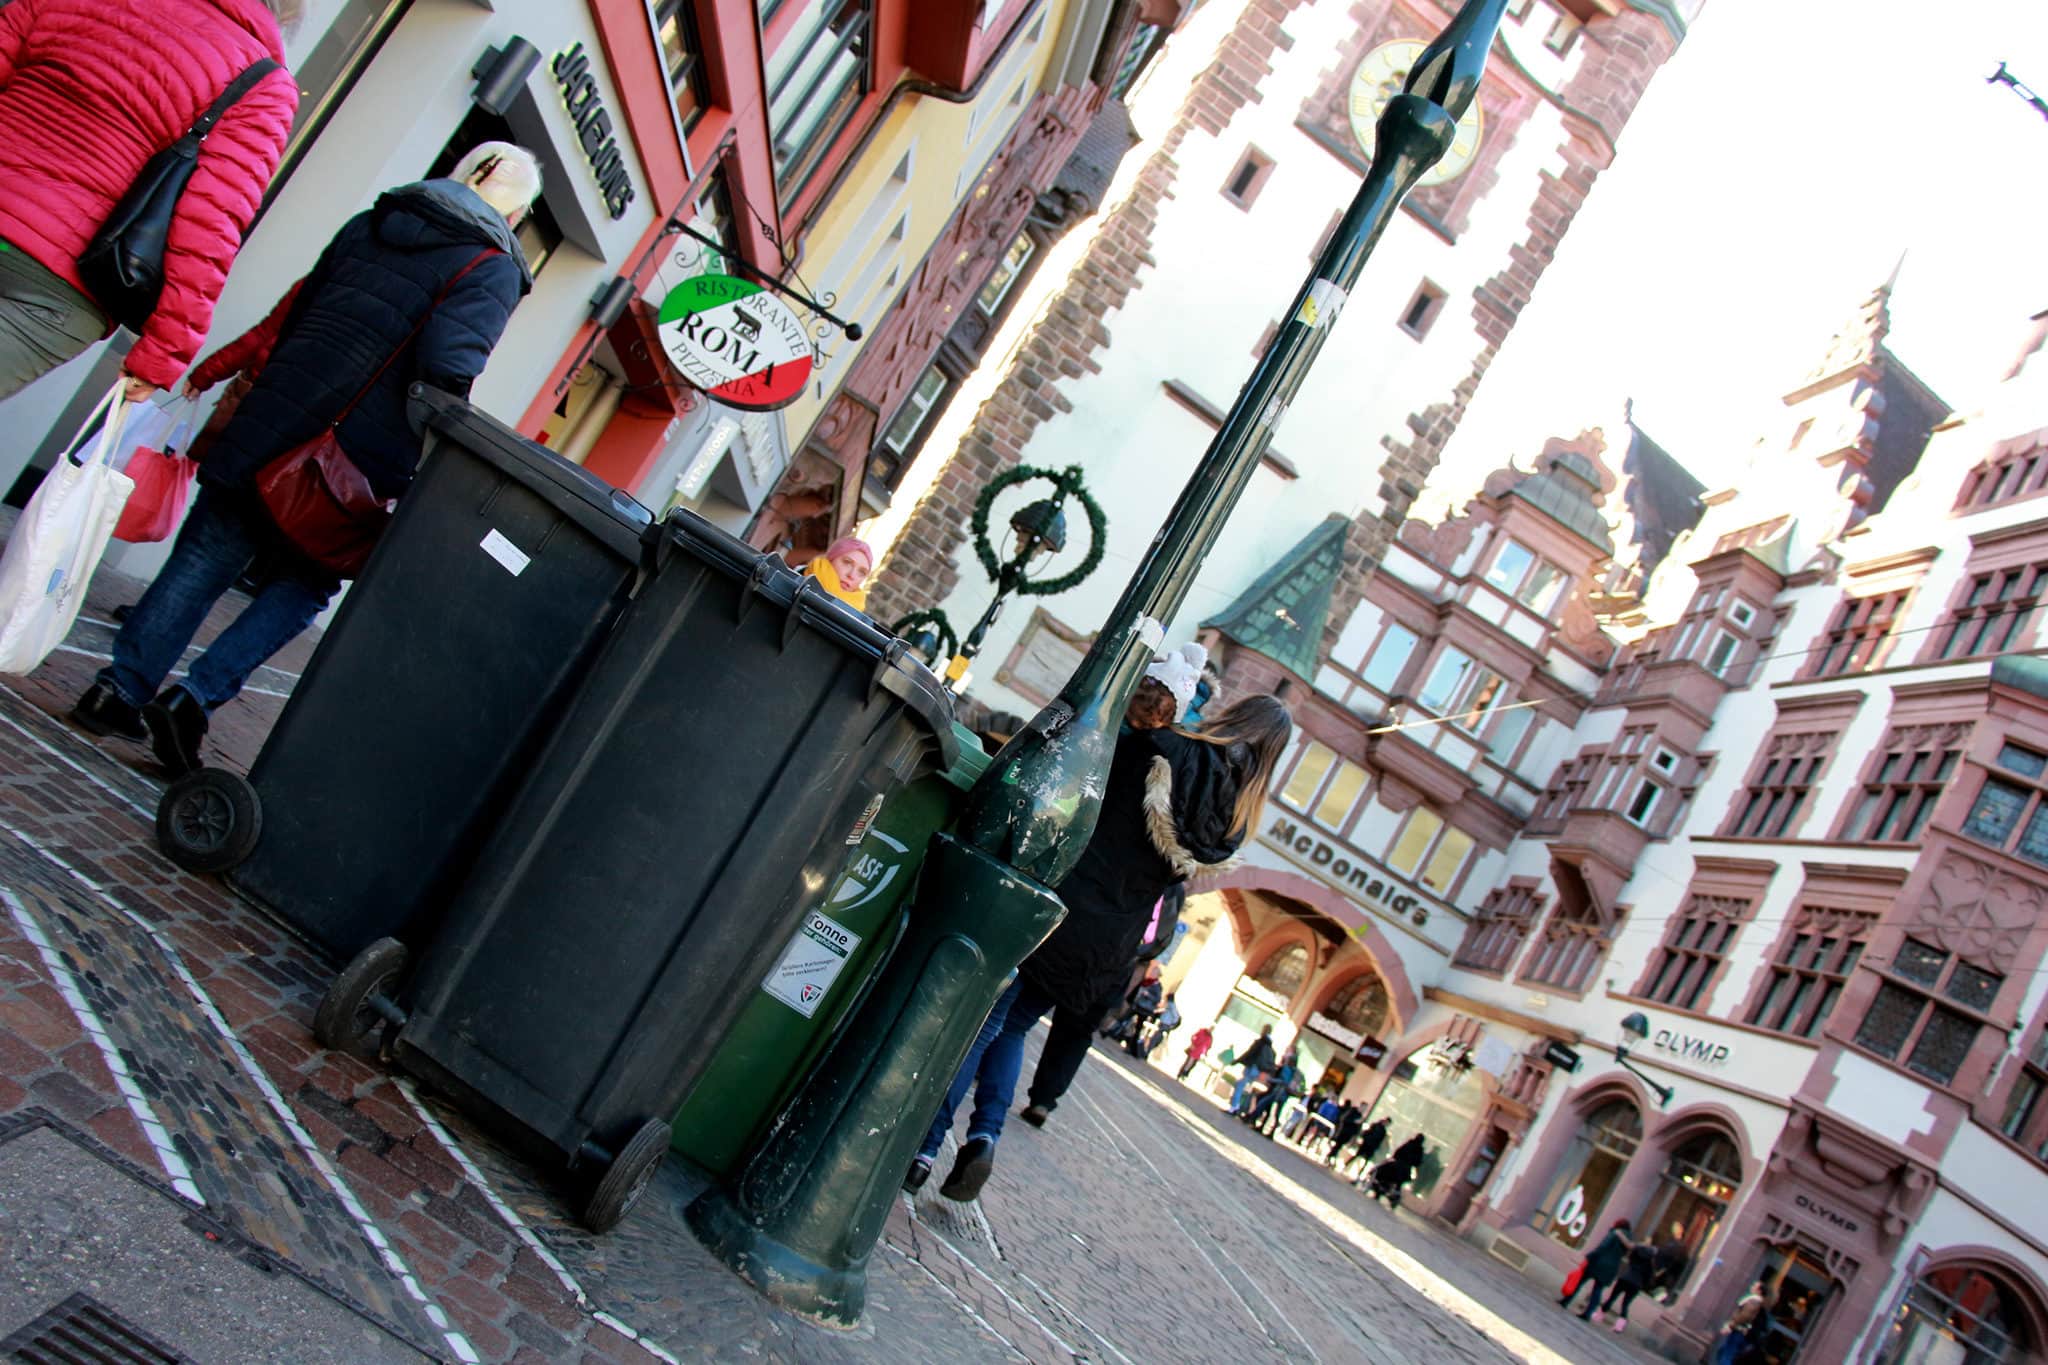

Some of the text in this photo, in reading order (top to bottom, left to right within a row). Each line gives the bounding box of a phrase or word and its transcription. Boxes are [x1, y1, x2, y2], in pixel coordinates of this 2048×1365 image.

[552, 42, 602, 130] JACK
[590, 137, 636, 222] JONES
[674, 309, 775, 388] ROMA
[695, 280, 808, 357] RISTORANTE
[671, 342, 755, 397] PIZZERIA
[853, 853, 884, 881] ASF
[1268, 817, 1431, 927] McDonald's
[1653, 1029, 1730, 1063] OLYMP
[1795, 1194, 1859, 1233] OLYMP
